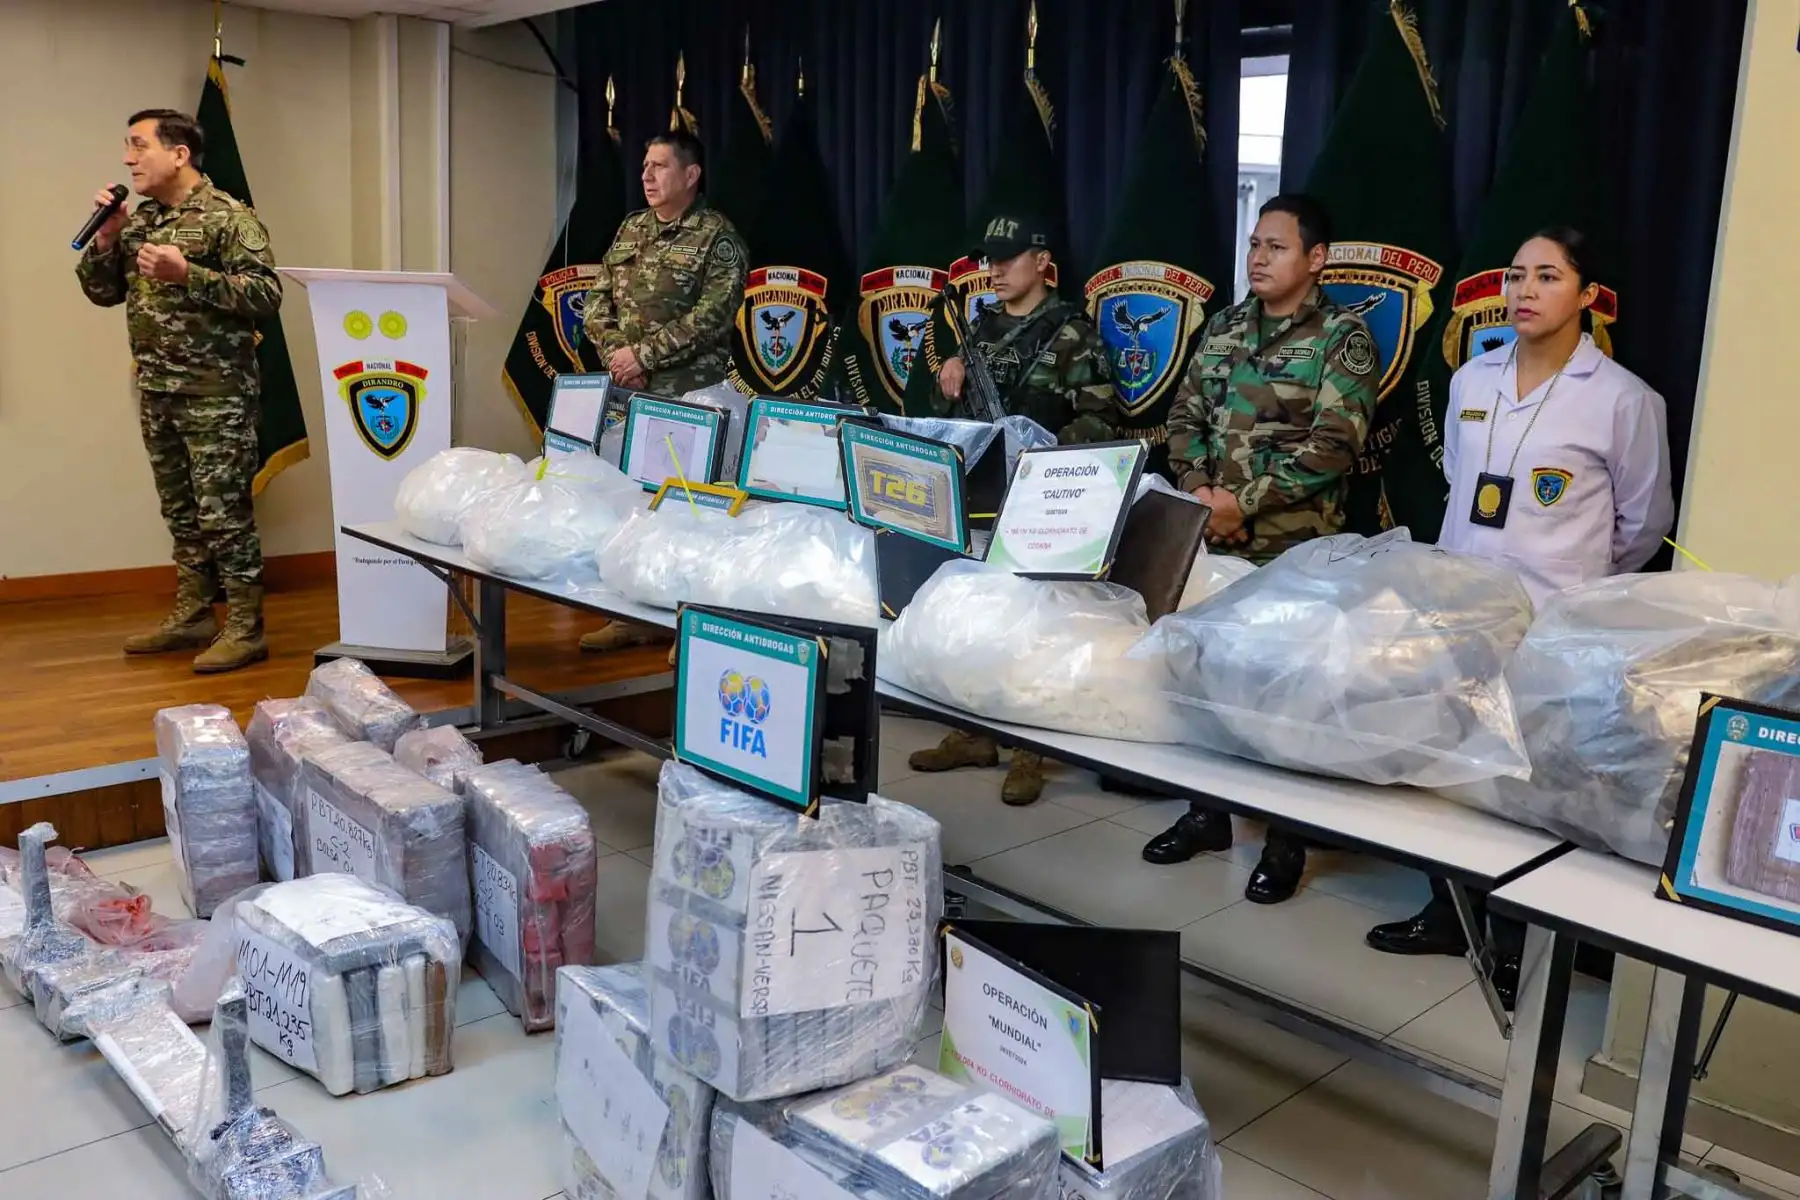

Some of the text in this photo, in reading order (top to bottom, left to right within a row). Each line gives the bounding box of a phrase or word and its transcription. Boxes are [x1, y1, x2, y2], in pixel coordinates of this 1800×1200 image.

[767, 269, 798, 281] NACIONAL
[896, 268, 931, 280] NACIONAL
[1328, 247, 1380, 260] ACIONAL
[1381, 249, 1402, 266] DEL
[1406, 258, 1438, 281] PERU
[1165, 267, 1181, 280] DEL
[1183, 277, 1210, 297] PERU
[362, 379, 404, 388] DIRANDRO
[770, 406, 836, 421] DIRECCIÓN ANTIDROG
[860, 433, 938, 457] DIRECCIÓN ANTIDROGAS
[1044, 462, 1100, 479] OPERACIÓN
[869, 469, 928, 508] T26
[702, 622, 795, 655] DIRECCIÓN ANTIDROGAS
[720, 716, 767, 760] FIFA
[1757, 726, 1800, 745] DIRE
[790, 908, 843, 957] 1
[844, 867, 894, 1001] PAQUETE
[982, 982, 1048, 1032] OPERACIÓN
